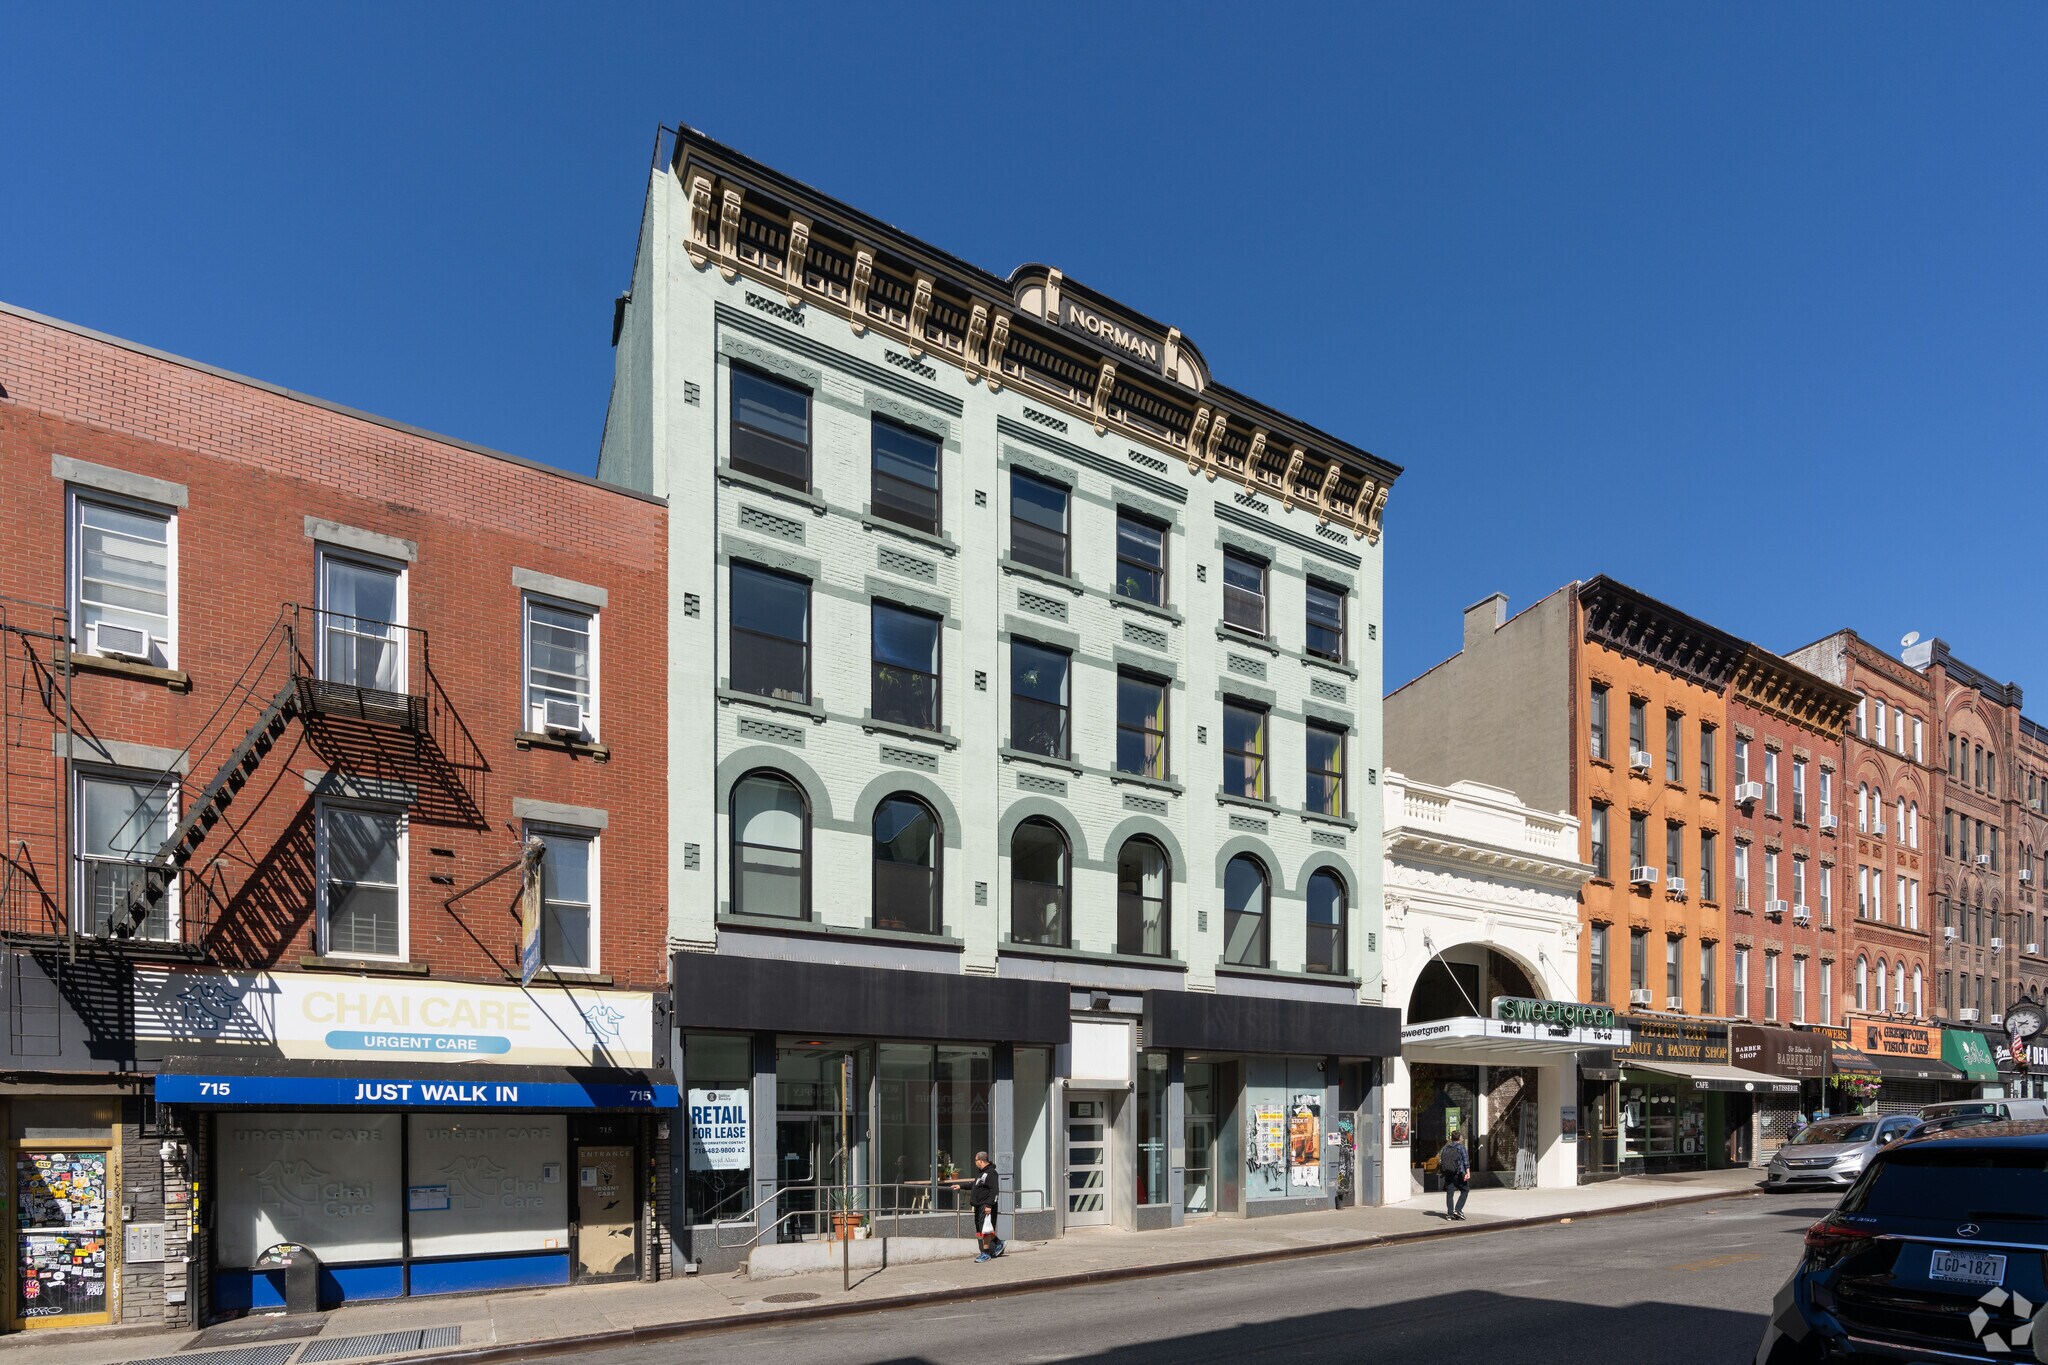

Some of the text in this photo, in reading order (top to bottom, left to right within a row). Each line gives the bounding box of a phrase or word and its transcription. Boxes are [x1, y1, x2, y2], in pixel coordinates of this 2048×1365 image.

[1070, 305, 1156, 364] NORMAN
[301, 990, 531, 1031] CHAI CARE
[1504, 998, 1616, 1029] sweetgreen
[1401, 1024, 1450, 1038] sweetgreen
[1501, 1024, 1521, 1035] LUNCH
[1548, 1028, 1569, 1038] DINNER
[1593, 1031, 1612, 1041] TO-GO
[1640, 1021, 1708, 1041] PETER PAN
[1812, 1027, 1848, 1041] FLOWERS
[1883, 1026, 1929, 1044] GREENPOINT
[364, 1035, 478, 1050] URGENT CARE
[1735, 1045, 1762, 1053] BARBER
[1883, 1041, 1929, 1055] VISION CARE
[1656, 1043, 1663, 1056] &
[1668, 1044, 1702, 1058] PASTRY
[1705, 1046, 1728, 1060] SHOP
[1777, 1053, 1804, 1066] BARBER
[1805, 1055, 1823, 1067] SHOP
[200, 1082, 231, 1096] 715
[1695, 1081, 1709, 1089] CAFE
[1772, 1084, 1799, 1092] PATISSERIE
[355, 1083, 518, 1102] JUST WALK IN
[629, 1090, 652, 1101] 715
[692, 1106, 746, 1125] RETAIL
[235, 1128, 383, 1141] URGENT CARE
[425, 1127, 552, 1140] URGENT CARE
[692, 1126, 746, 1139] FOR LEASE
[322, 1182, 371, 1200] Chai
[500, 1176, 542, 1193] Chai
[501, 1193, 544, 1209] Care
[323, 1201, 373, 1217] Care
[1950, 1251, 1986, 1261] NEW YORK
